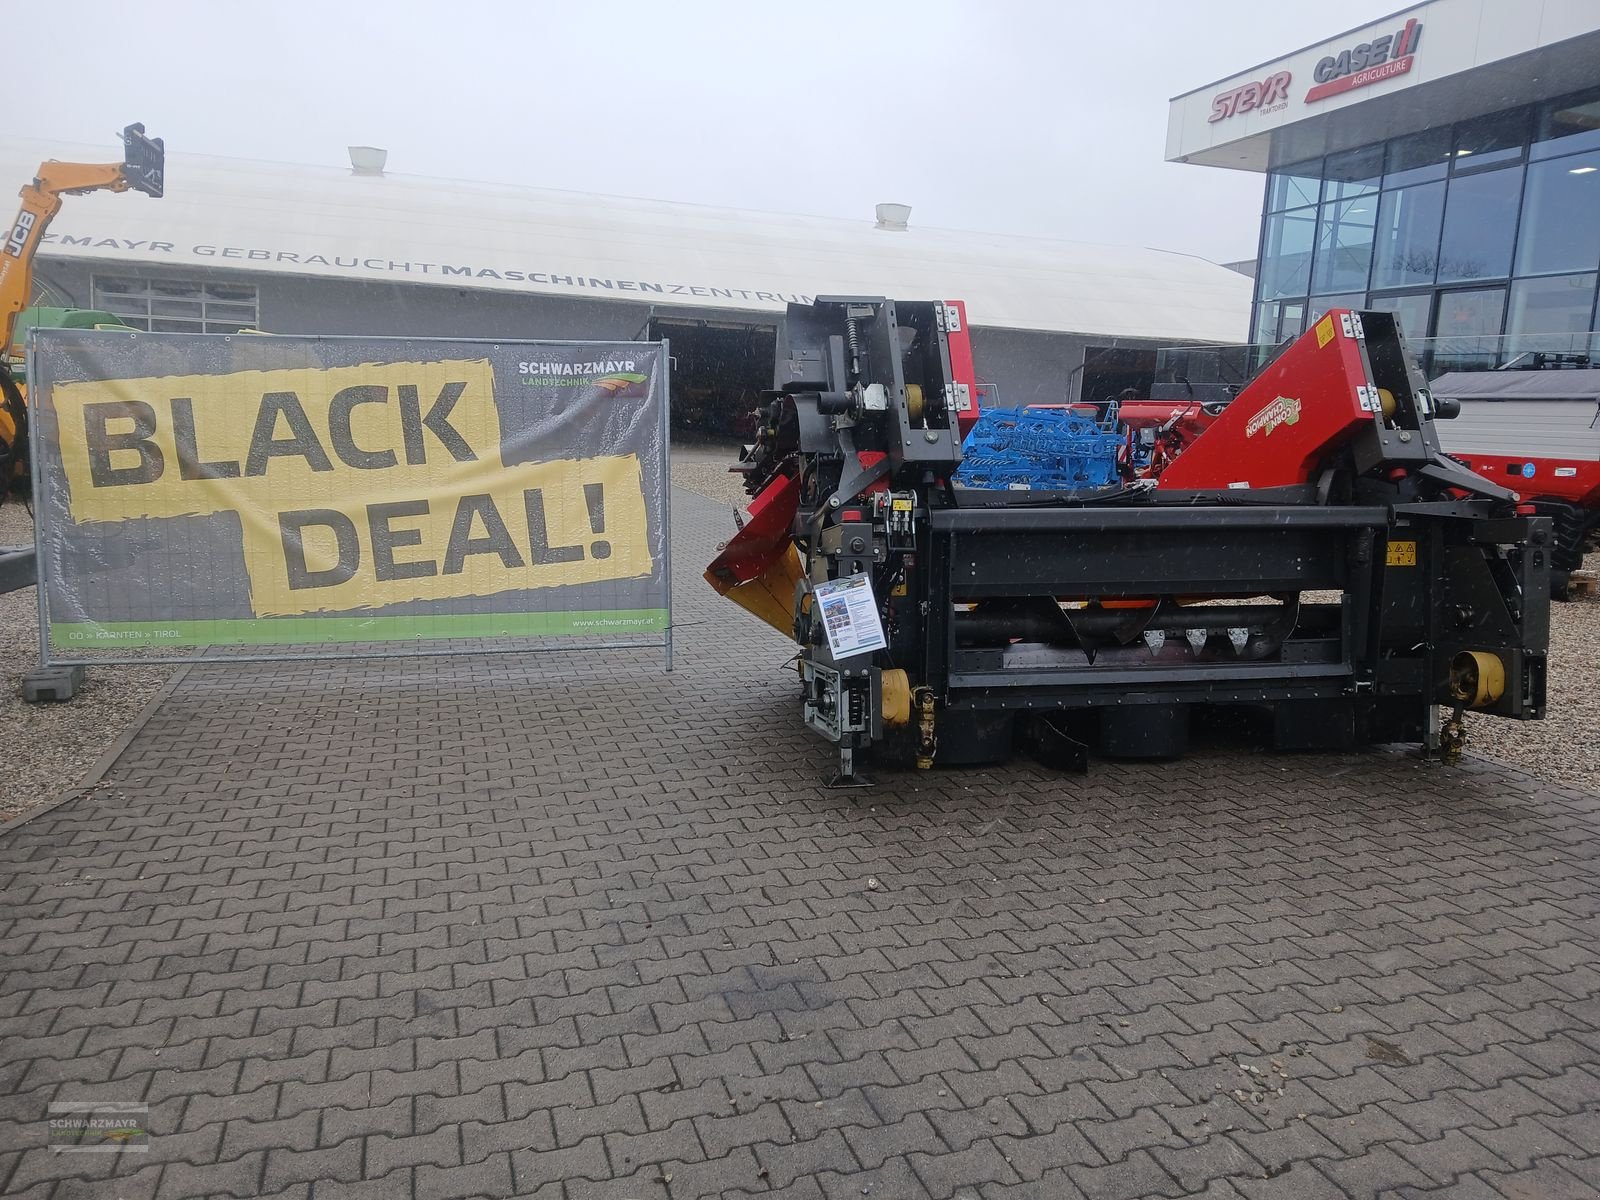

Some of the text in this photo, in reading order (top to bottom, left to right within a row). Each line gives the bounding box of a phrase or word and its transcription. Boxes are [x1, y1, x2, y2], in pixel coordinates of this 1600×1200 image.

[1313, 34, 1394, 83] CASE
[1351, 59, 1407, 86] AGRICULTURE
[1207, 71, 1292, 123] STEYR
[1260, 102, 1289, 117] TRAKTOREN
[8, 211, 35, 257] JCB
[518, 360, 636, 376] SCHWARZMAYR
[522, 376, 590, 387] LANDTECHNIK
[1246, 402, 1285, 436] CHAMPION
[1270, 407, 1292, 429] CORN
[83, 381, 480, 489] BLACK
[278, 482, 612, 590] DEAL!
[153, 630, 182, 639] TIROL
[572, 617, 654, 627] www.schwarzmayr.at
